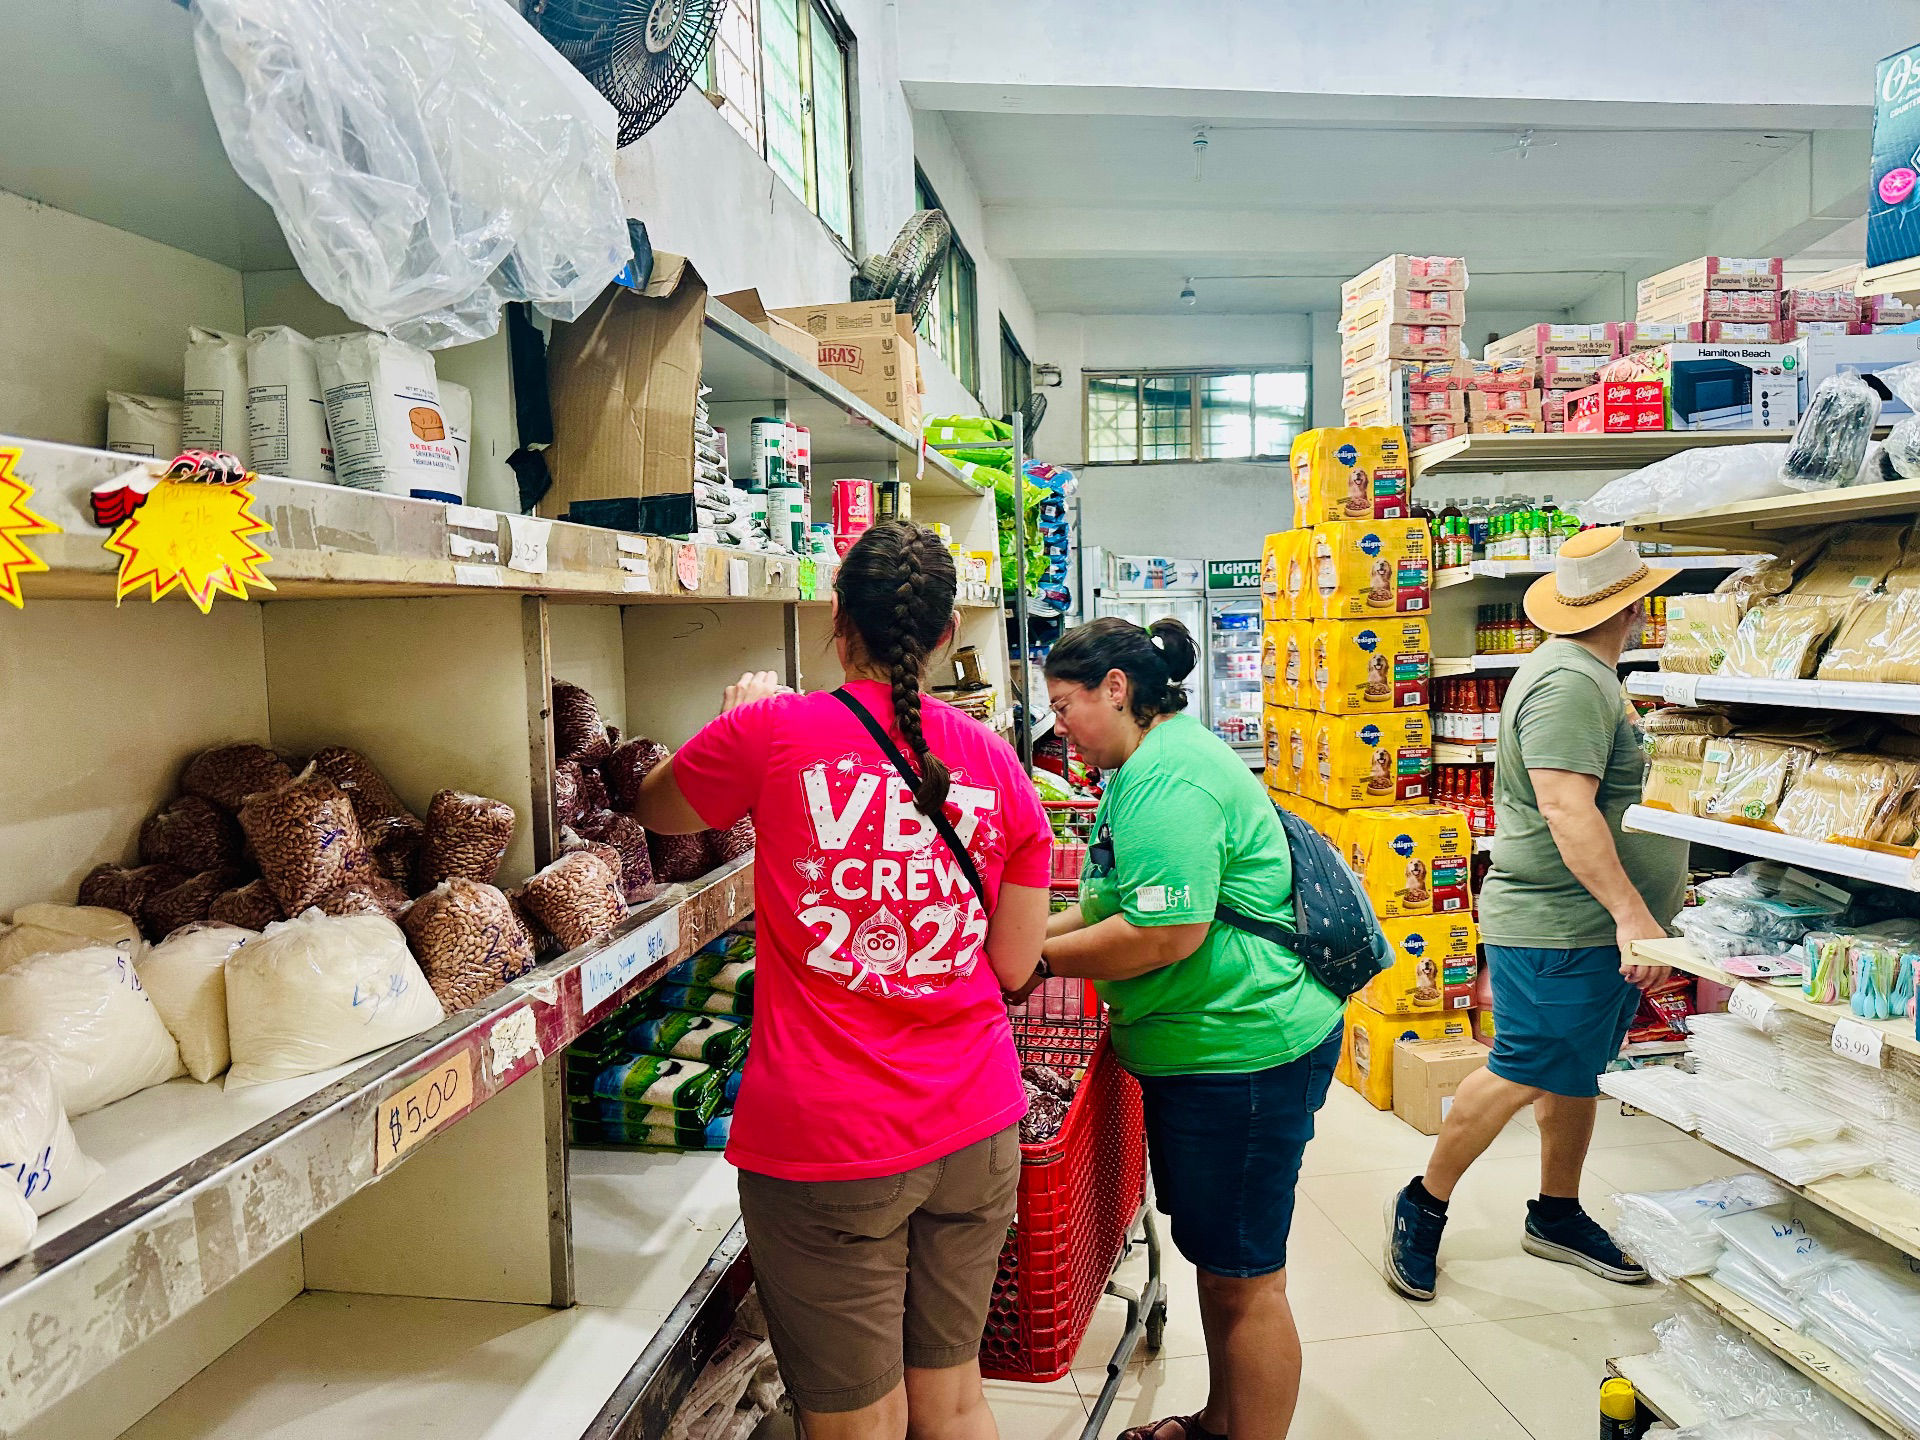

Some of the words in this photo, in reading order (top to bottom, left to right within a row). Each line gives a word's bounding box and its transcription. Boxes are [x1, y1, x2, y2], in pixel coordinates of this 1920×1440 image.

[1698, 349, 1740, 357] Hamilton
[1742, 350, 1771, 358] Beach
[410, 443, 432, 452] BEBE
[803, 768, 996, 852] VBT
[831, 858, 970, 902] CREW
[589, 962, 613, 992] White
[617, 953, 636, 974] Sugar
[1834, 1034, 1870, 1056] $3.99
